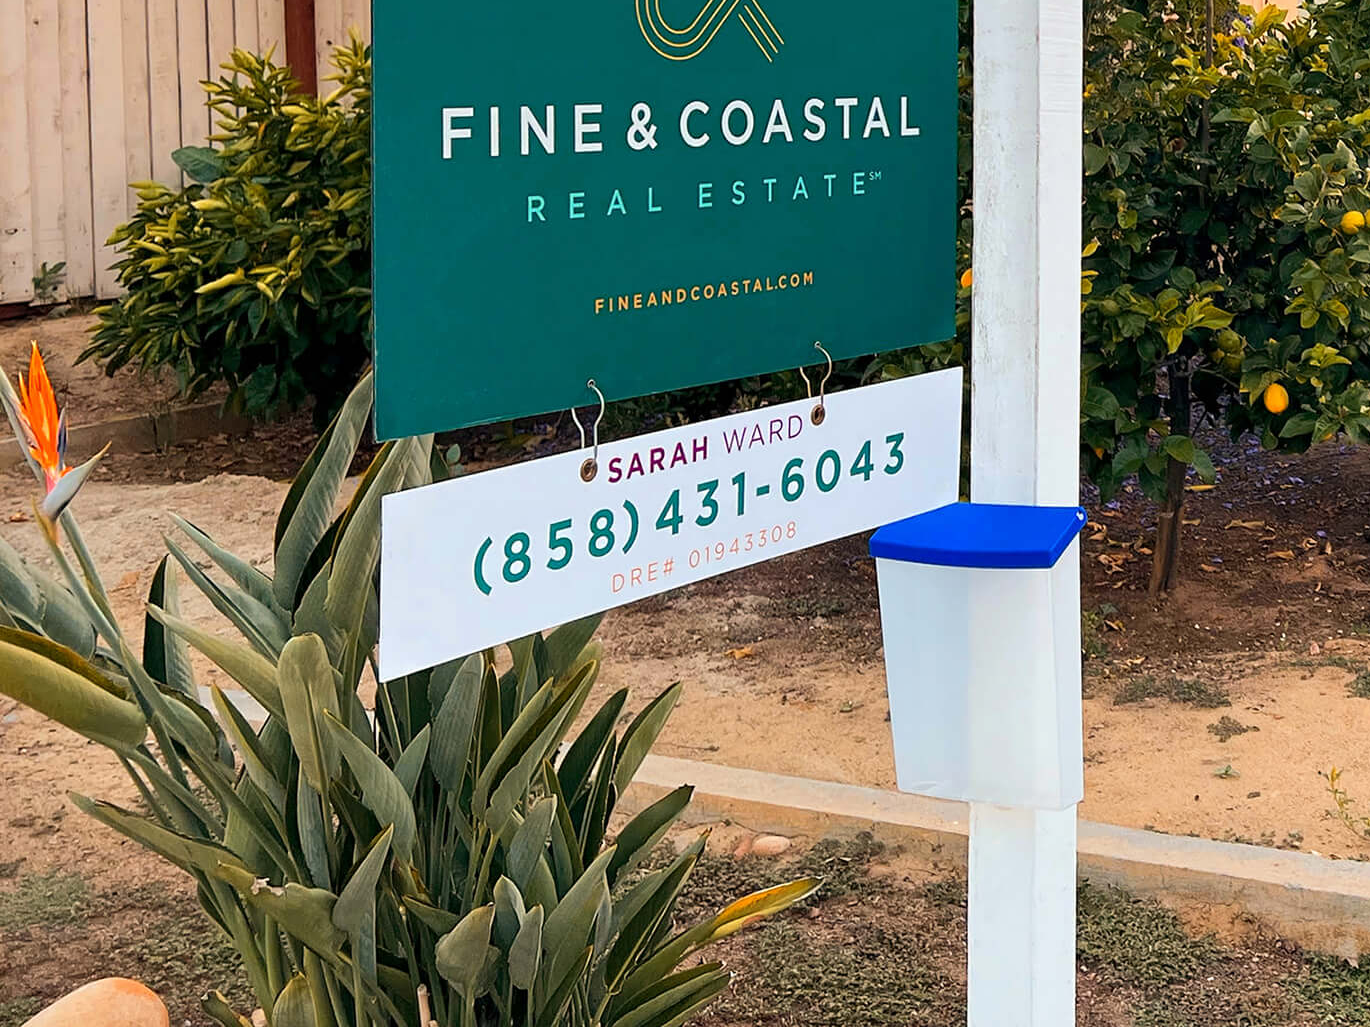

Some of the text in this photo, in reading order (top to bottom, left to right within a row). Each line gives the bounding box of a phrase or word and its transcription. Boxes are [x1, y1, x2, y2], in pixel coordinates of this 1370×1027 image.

[442, 96, 921, 160] FINE & COASTAL
[527, 186, 663, 223] REAL
[593, 271, 815, 315] FINEANDCOASTAL.COM
[607, 414, 803, 484] SARAH WARD
[611, 520, 797, 595] DRE# 01943308
